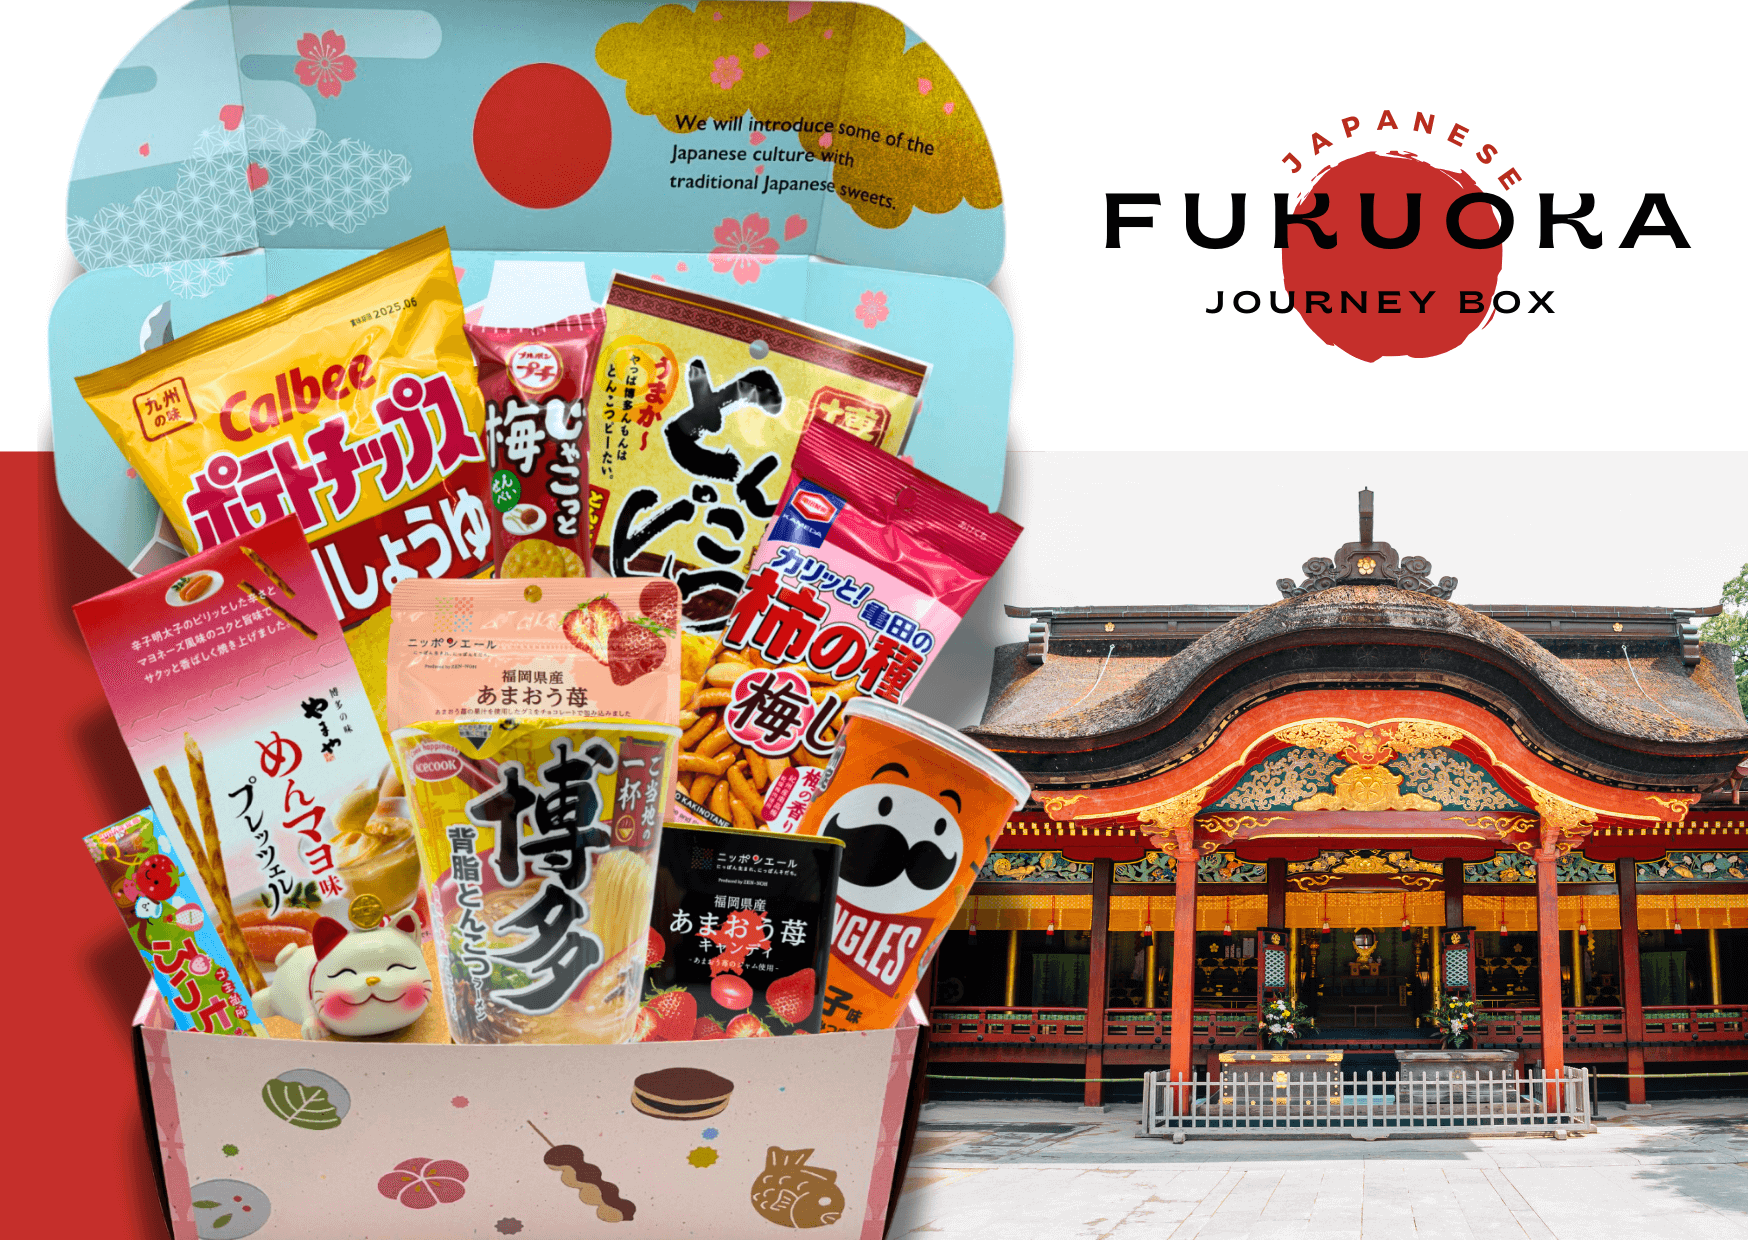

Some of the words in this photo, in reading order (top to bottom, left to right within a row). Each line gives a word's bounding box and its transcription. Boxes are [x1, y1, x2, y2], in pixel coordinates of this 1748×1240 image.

[675, 114, 707, 131] We
[713, 116, 743, 132] will
[748, 116, 834, 133] introduce
[838, 123, 881, 143] some
[886, 132, 905, 148] of
[907, 136, 935, 156] the
[670, 144, 747, 163] Japanese
[753, 146, 815, 162] culture
[821, 151, 855, 168] with
[670, 174, 758, 190] traditional
[762, 175, 835, 195] Japanese
[840, 183, 896, 210] sweets.
[373, 297, 418, 319] 2025.06
[516, 361, 556, 382] プチ
[145, 386, 180, 415] 九州
[154, 407, 182, 428] の味
[219, 354, 377, 442] Calbee
[485, 399, 546, 474] 梅
[186, 373, 484, 549] ポテトチップス
[545, 397, 587, 536] じゃこっと
[782, 513, 822, 539] KAMEDA
[310, 487, 492, 621] しょうゆ
[131, 586, 277, 651] 辛子明太子のピリッとした辛さと
[137, 606, 272, 667] マヨネーズ風味のコクと旨味で
[726, 567, 924, 704] 柿の種
[860, 601, 934, 653] 亀田の
[144, 620, 292, 684] サクッと香ばしく焼き上げました。
[407, 637, 498, 650] ニッポンエール
[476, 685, 589, 709] あまおう苺
[501, 669, 564, 685] 福岡県産
[300, 696, 342, 755] やまや
[415, 759, 458, 774] ACECOOK
[618, 758, 646, 812] 一杯
[254, 730, 344, 899] めんマヨ味
[681, 797, 730, 828] KAKINOTANE
[228, 776, 294, 918] プレッツェル
[717, 852, 798, 868] ニッポンエール
[468, 740, 616, 1013] 博多
[714, 894, 767, 912] 福岡県産
[669, 908, 808, 947] あまおう苺
[698, 937, 773, 959] キャンディ
